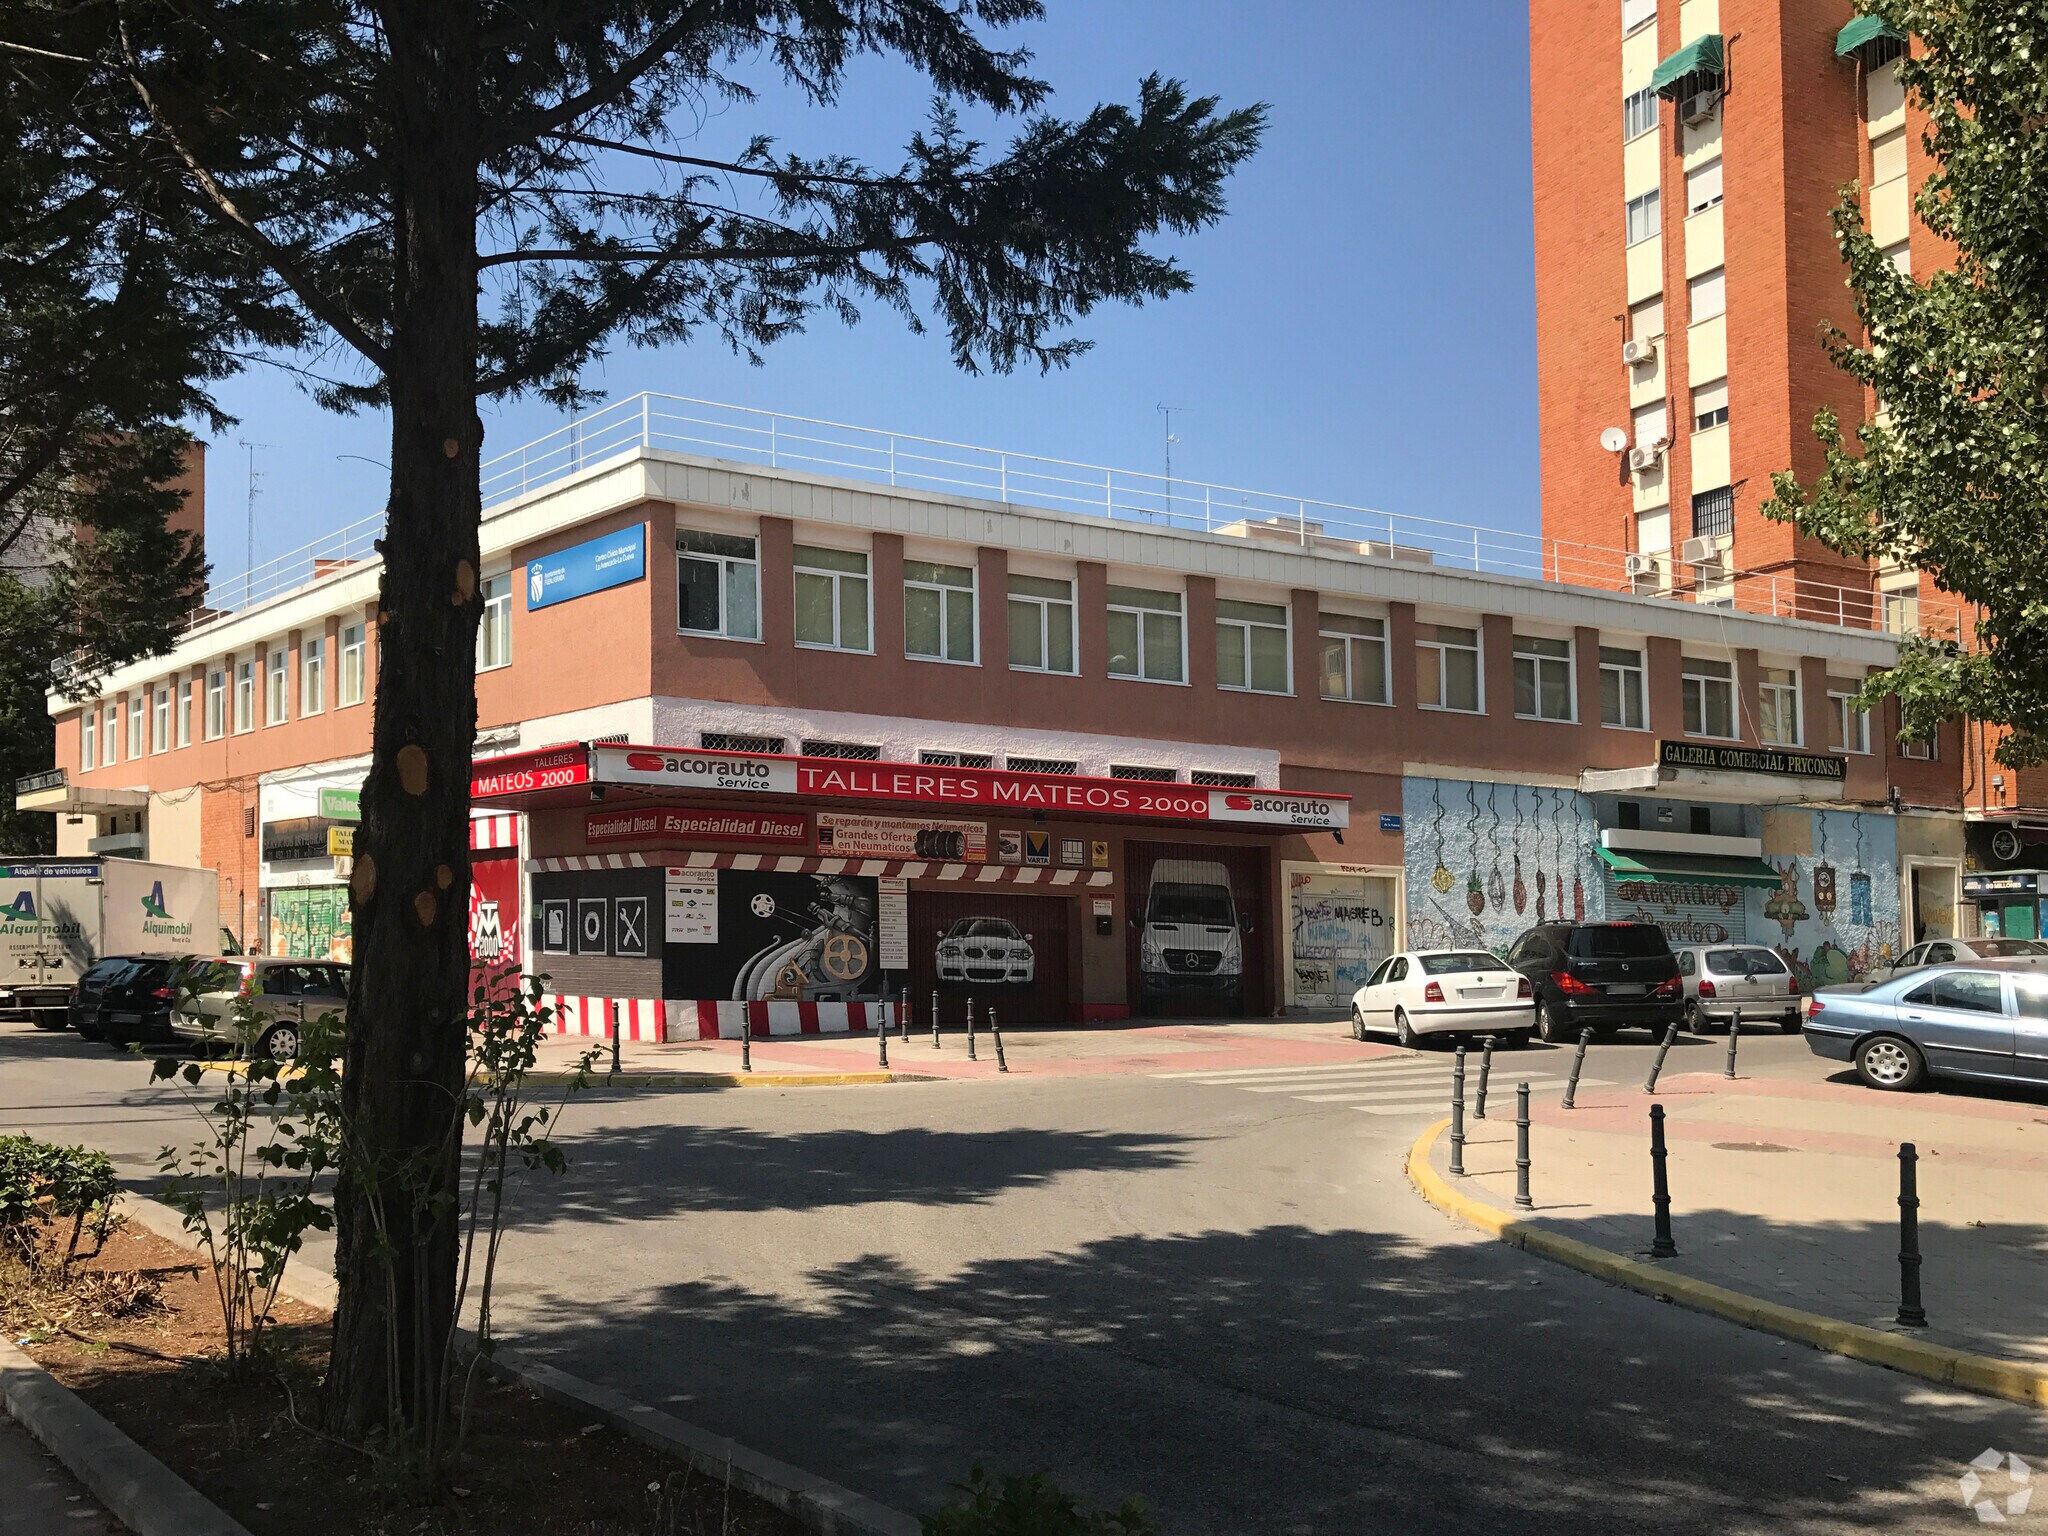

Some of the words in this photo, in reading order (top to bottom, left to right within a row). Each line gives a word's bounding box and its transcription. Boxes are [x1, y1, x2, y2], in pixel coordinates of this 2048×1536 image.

[534, 753, 574, 768] TALLERES
[1665, 745, 1716, 766] GALERIA
[1719, 751, 1785, 771] COMERCIAL
[1787, 756, 1841, 776] PRYCONSA
[478, 769, 534, 794] MATEOS
[541, 769, 574, 787] 2000
[717, 776, 770, 790] Service
[800, 768, 979, 799] TALLERES
[992, 781, 1130, 808] MATEOS
[1138, 796, 1208, 814] 2000
[588, 818, 632, 838] Especialidad
[634, 816, 657, 832] Diesel
[664, 815, 755, 835] Especialidad
[759, 820, 804, 837] Diesel
[822, 815, 834, 825] Se
[874, 820, 881, 830] y
[881, 820, 931, 831] montamos
[931, 821, 984, 834] Neumaticos
[1291, 814, 1330, 825] Service
[836, 829, 878, 841] Grandes
[880, 831, 917, 842] Ofertas
[838, 842, 850, 850] en
[853, 841, 910, 853] Neumaticos
[43, 867, 53, 875] de
[142, 921, 192, 937] Alquimobil
